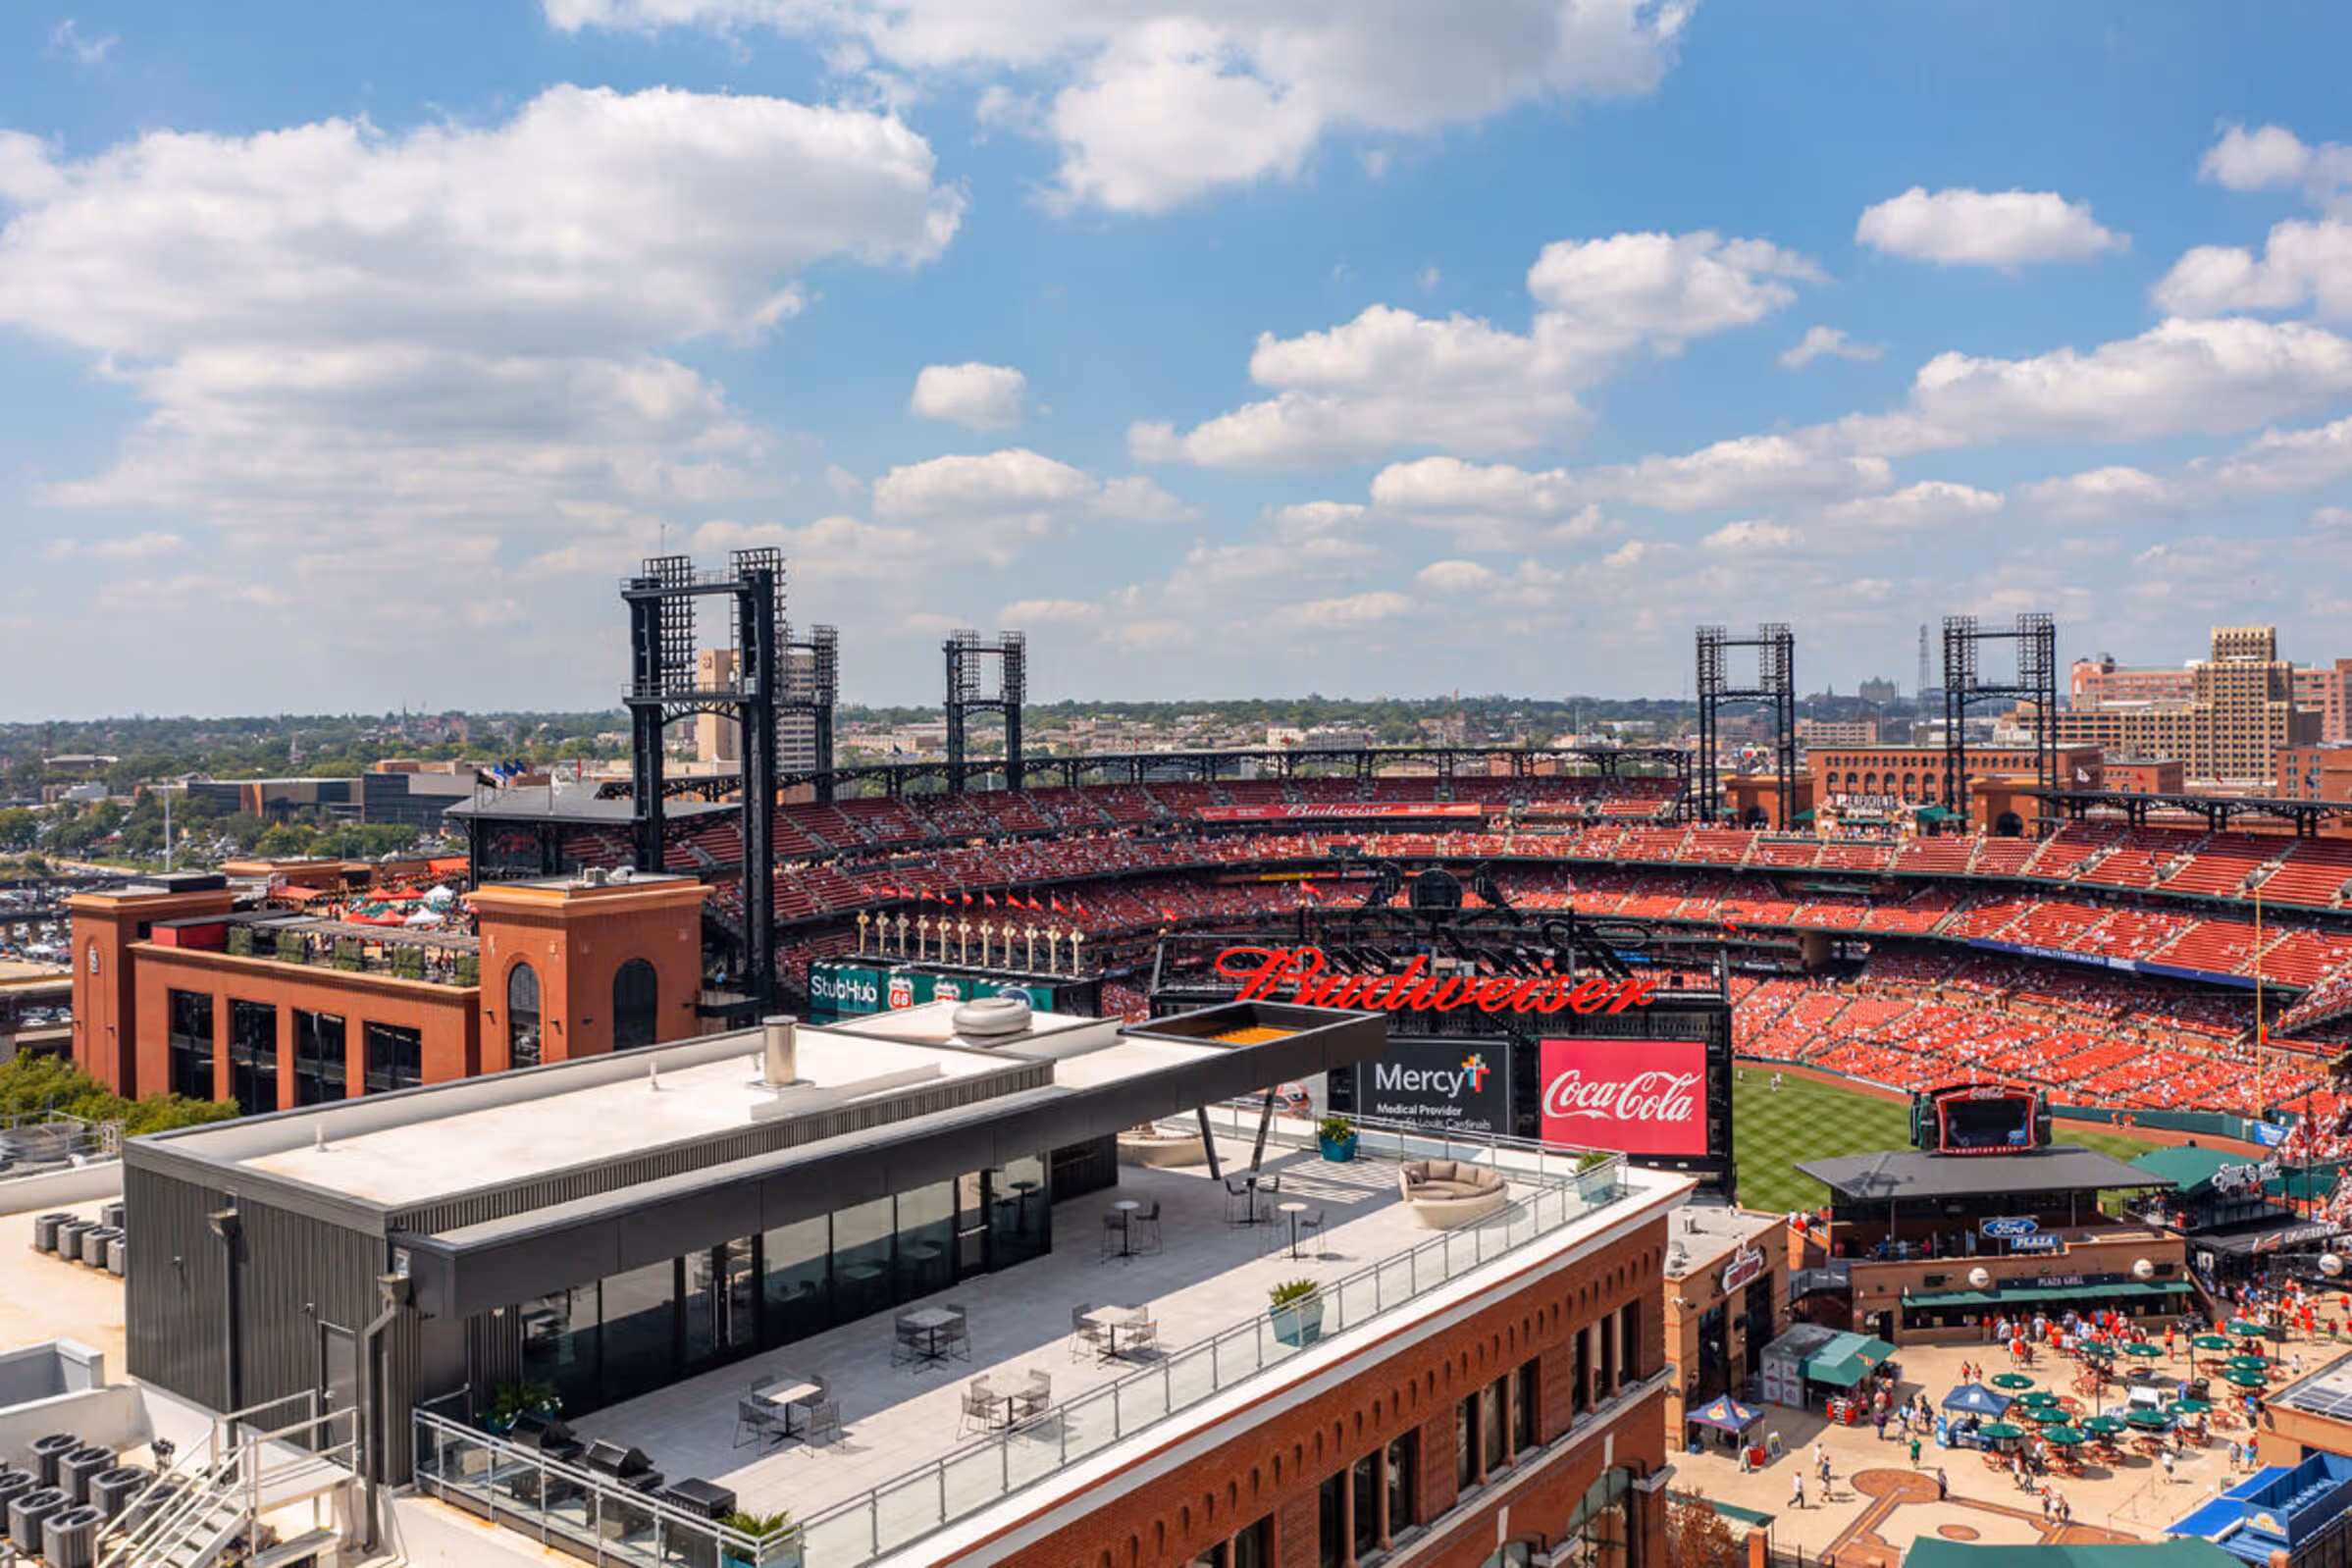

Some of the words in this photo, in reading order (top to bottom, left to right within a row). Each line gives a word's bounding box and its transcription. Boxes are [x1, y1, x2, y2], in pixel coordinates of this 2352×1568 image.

[1280, 804, 1391, 817] Budweiser
[1215, 946, 1658, 1015] Budweiser
[810, 974, 877, 1003] StubHub
[893, 992, 909, 1007] 66
[1375, 1063, 1465, 1098] Mercy
[1542, 1070, 1703, 1122] Coca-Cola
[1377, 1102, 1417, 1115] Medical
[1419, 1104, 1462, 1117] Provider
[1445, 1118, 1491, 1130] Cardinals
[1993, 1221, 2027, 1235] Ford
[2016, 1236, 2054, 1249] PLAZA
[2037, 1278, 2062, 1287] PLAZA
